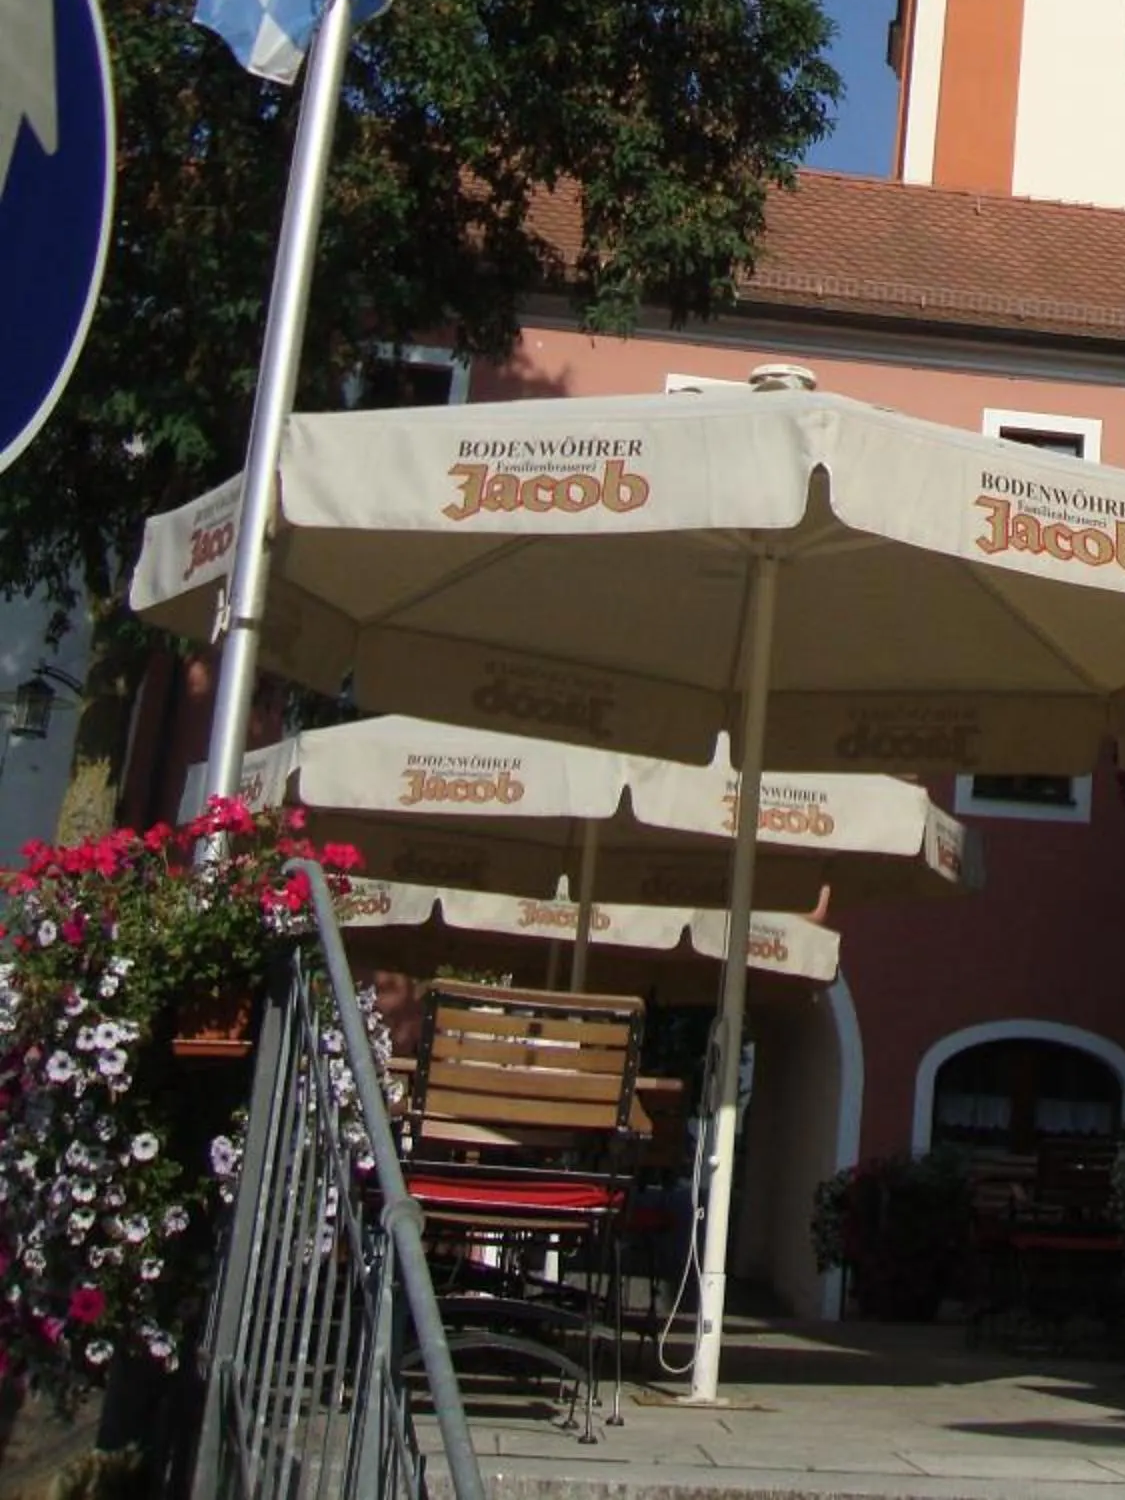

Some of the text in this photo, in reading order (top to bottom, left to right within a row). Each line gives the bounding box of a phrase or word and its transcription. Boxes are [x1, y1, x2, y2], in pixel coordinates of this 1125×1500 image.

[458, 435, 643, 458] BODENWÖHRER
[495, 460, 598, 474] Familienbrauerei
[442, 459, 650, 522] Jacob
[183, 521, 235, 581] Jaco
[399, 769, 525, 806] Jacob
[725, 781, 829, 804] BNWÖHRER
[747, 936, 789, 962] cob
